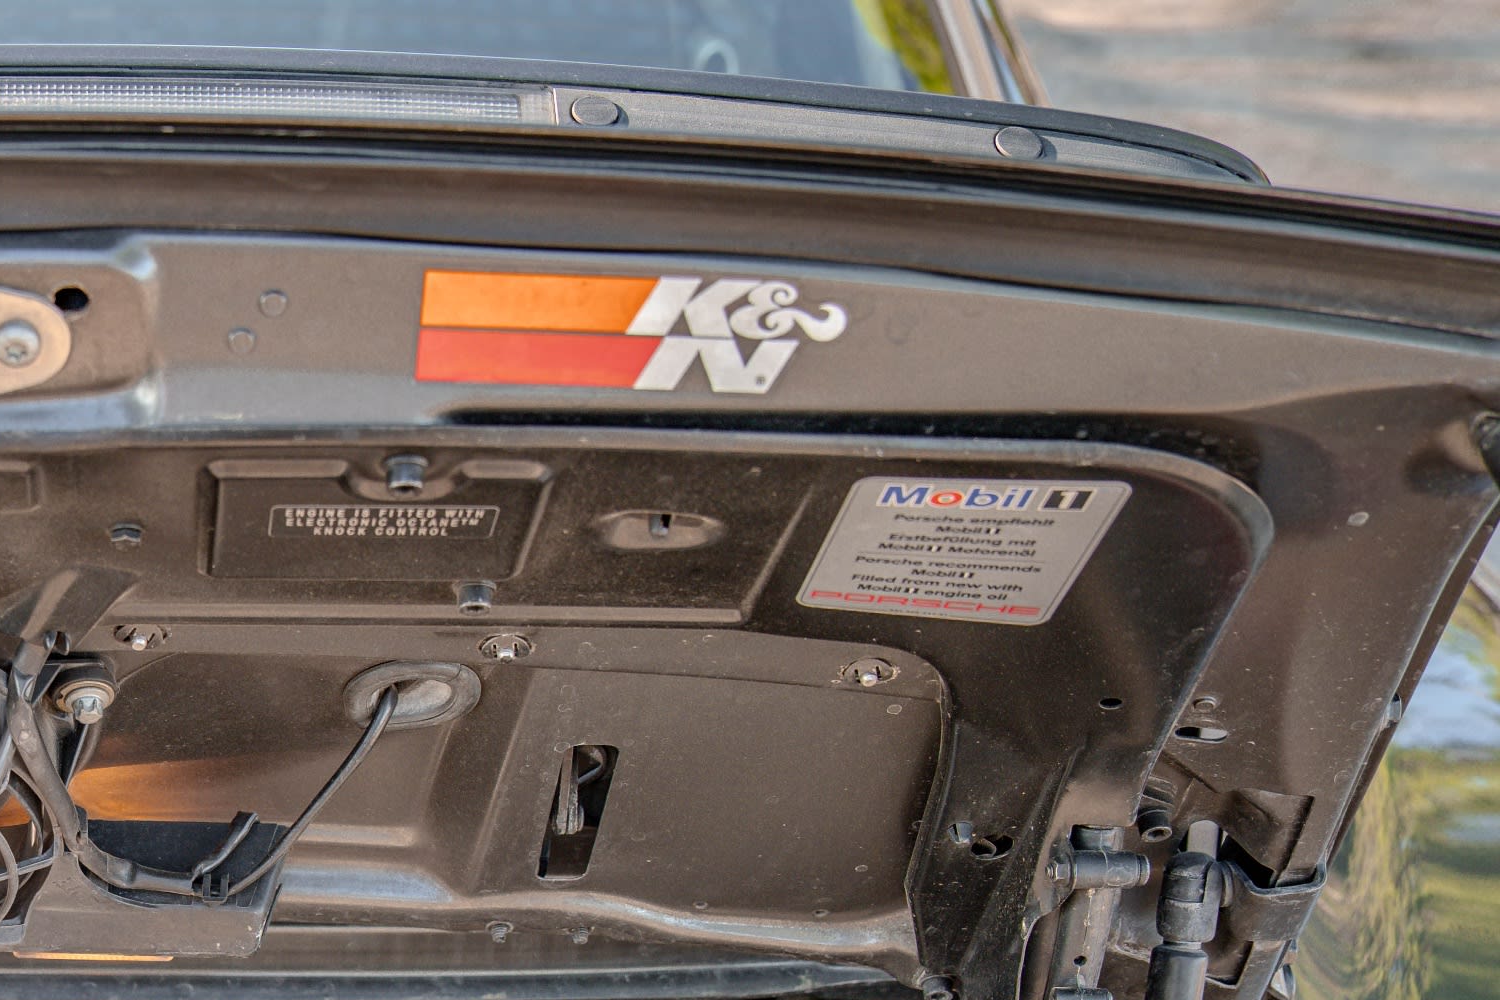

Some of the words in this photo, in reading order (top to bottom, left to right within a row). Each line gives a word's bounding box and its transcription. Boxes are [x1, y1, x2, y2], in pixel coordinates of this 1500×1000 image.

[881, 486, 1034, 508] Mobil
[285, 508, 346, 518] ENGINE
[354, 508, 370, 518] IS
[379, 508, 437, 518] FITTED
[445, 508, 485, 518] WITH
[894, 513, 964, 524] Porsche
[970, 516, 1056, 527] empfiehlt
[286, 517, 388, 527] ELECTRONIC
[313, 526, 367, 536] KNOCK
[374, 526, 449, 536] CONTROL
[935, 525, 982, 535] Mobil
[888, 533, 1002, 547] Erstbefüllung
[1008, 538, 1037, 547] mit
[878, 542, 923, 552] Mobil
[947, 546, 1036, 557] Motorenöl
[854, 554, 923, 567] Porsche
[928, 559, 1042, 574] recommends
[911, 568, 956, 578] Mobil
[851, 573, 897, 584] Filled
[900, 577, 943, 588] from
[945, 581, 982, 590] new
[987, 582, 1024, 593] with
[856, 583, 901, 594] Mobil
[924, 588, 980, 600] engine
[987, 590, 1008, 601] oil
[811, 590, 1041, 616] PORSCHE
